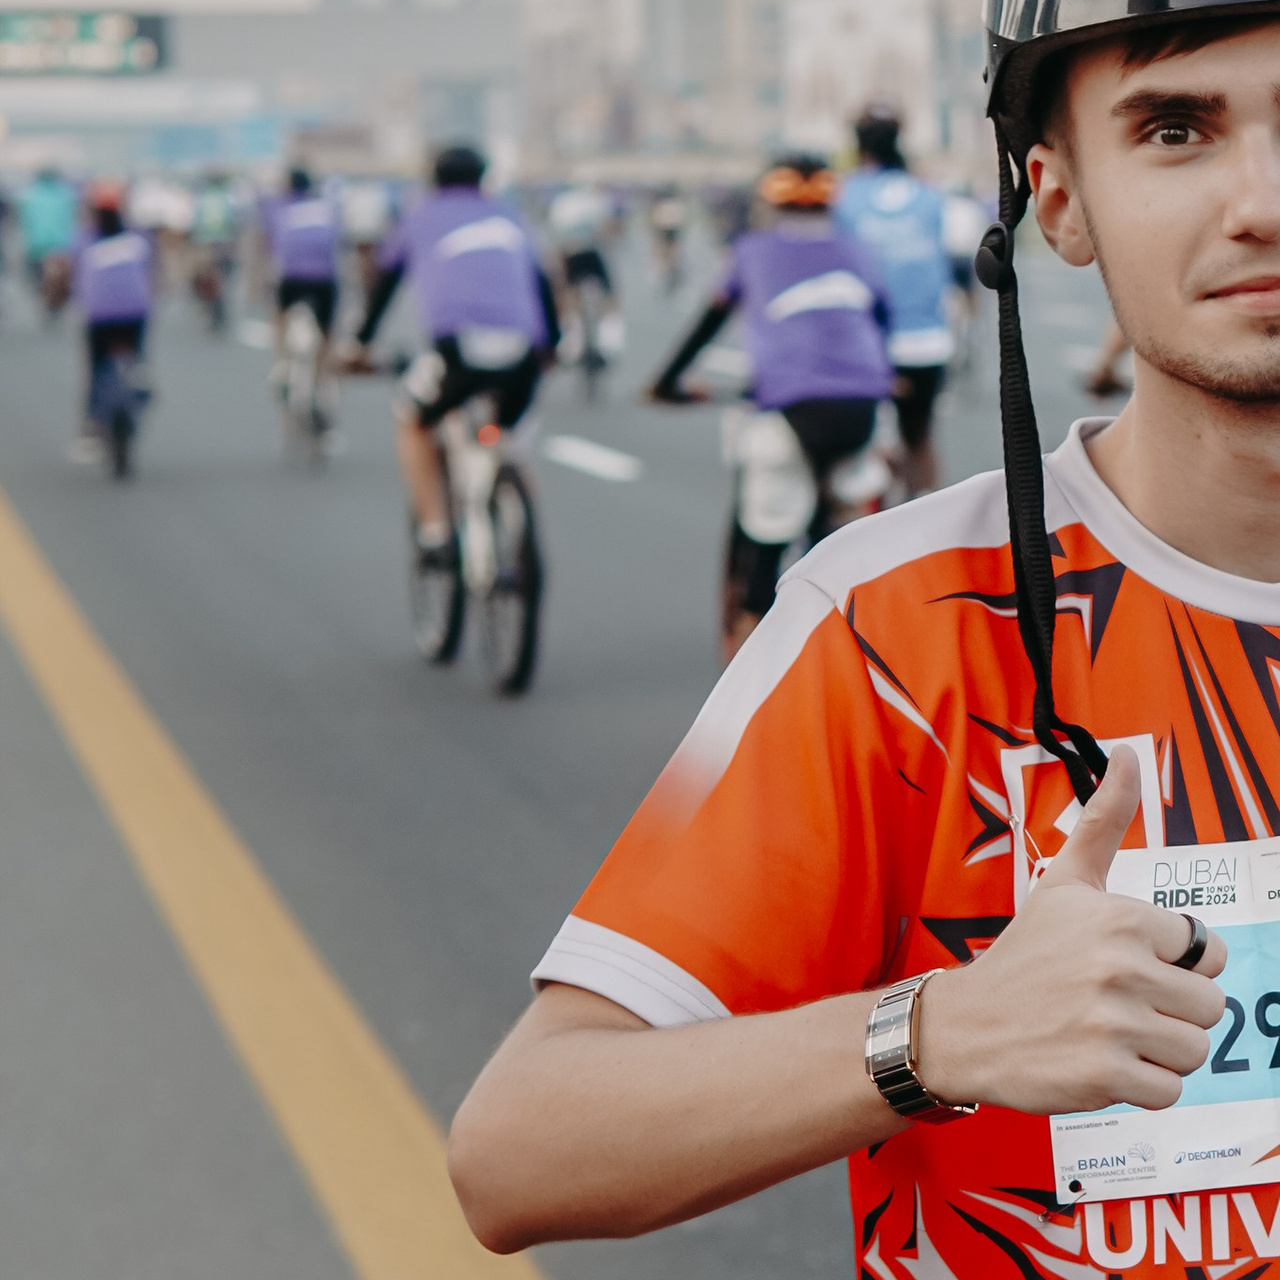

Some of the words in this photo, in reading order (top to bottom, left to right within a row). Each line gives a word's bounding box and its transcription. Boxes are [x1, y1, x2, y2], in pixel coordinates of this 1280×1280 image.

[1153, 857, 1237, 888] DUBAI
[1217, 884, 1236, 893] NOV
[1153, 887, 1204, 909] RIDE
[1206, 892, 1236, 905] 2024
[1065, 1122, 1103, 1131] association
[1187, 1148, 1242, 1161] DECATHLON
[1078, 1155, 1126, 1170] BRAIN
[1068, 1170, 1126, 1181] PERFORMANCE
[1127, 1166, 1157, 1175] CENTRE
